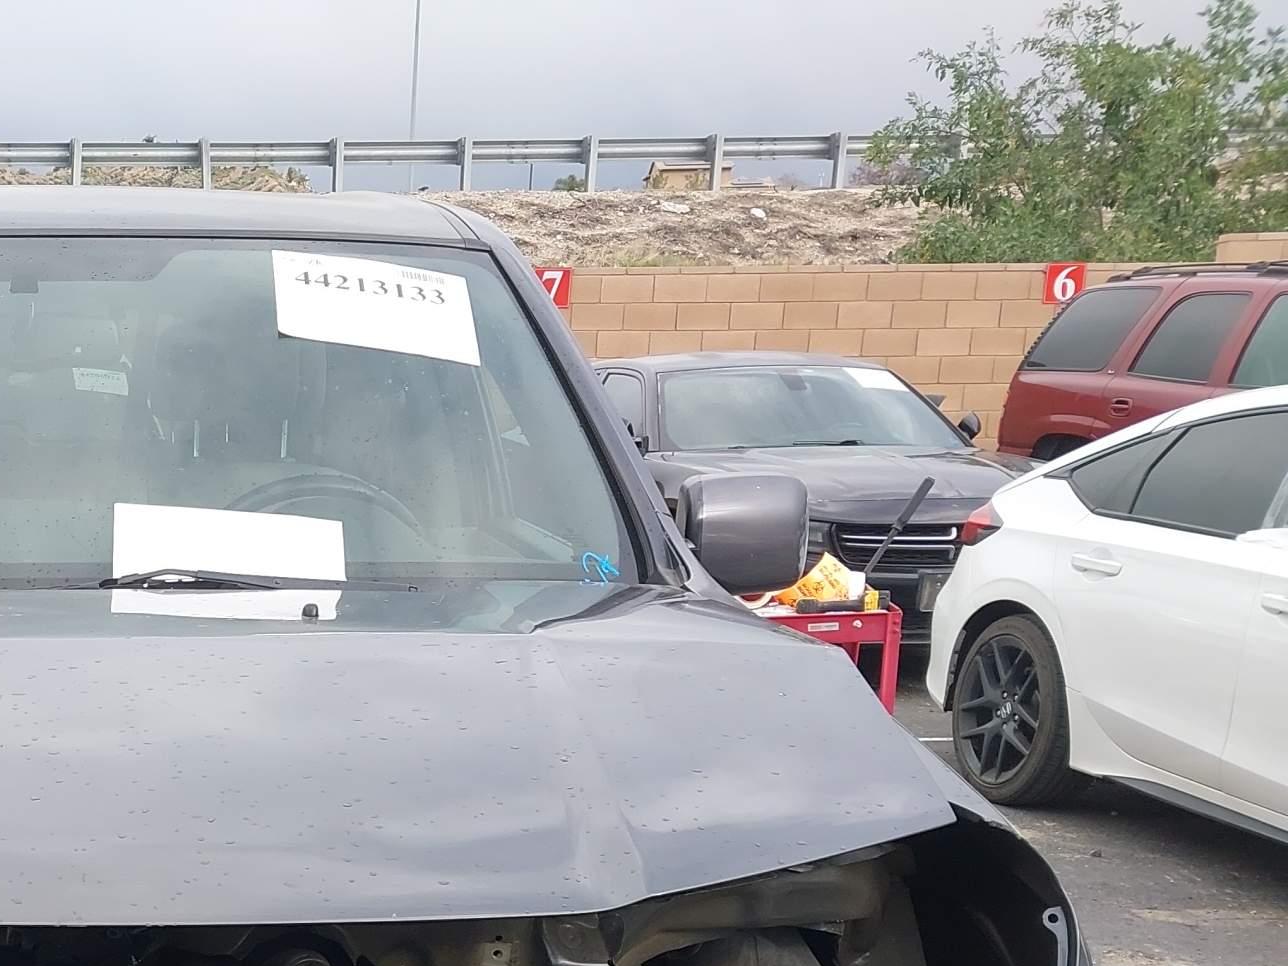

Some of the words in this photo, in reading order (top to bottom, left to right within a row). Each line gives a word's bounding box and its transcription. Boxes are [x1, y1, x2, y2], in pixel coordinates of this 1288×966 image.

[295, 271, 446, 305] 44213133
[542, 270, 564, 301] 7
[1053, 265, 1080, 301] 6
